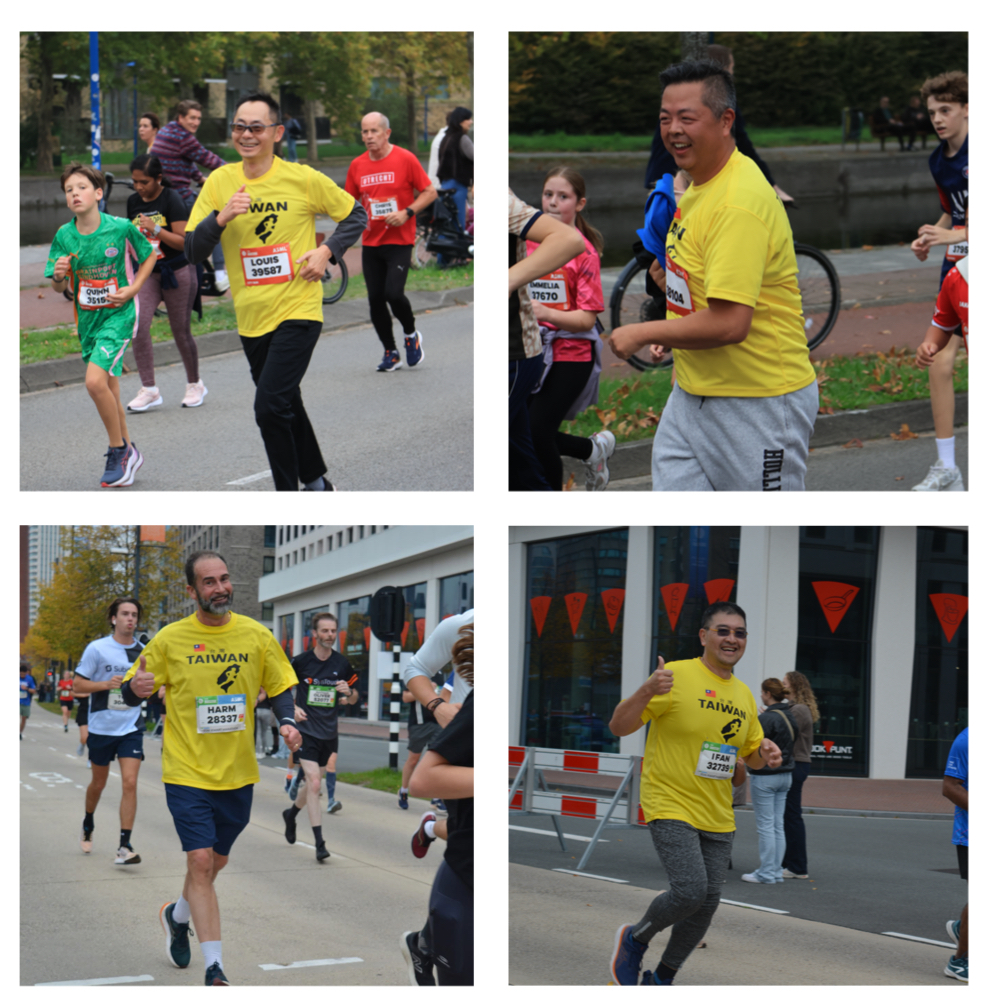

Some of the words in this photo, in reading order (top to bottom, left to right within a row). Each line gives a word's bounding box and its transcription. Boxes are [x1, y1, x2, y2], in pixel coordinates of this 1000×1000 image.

[250, 256, 279, 267] LOUIS
[251, 265, 282, 277] 39587
[86, 287, 110, 296] QUINN
[186, 653, 249, 665] TAIWAN
[207, 705, 236, 714] HARM
[698, 698, 747, 720] TAIWAN
[207, 714, 237, 724] 28337
[706, 762, 730, 773] 32739
